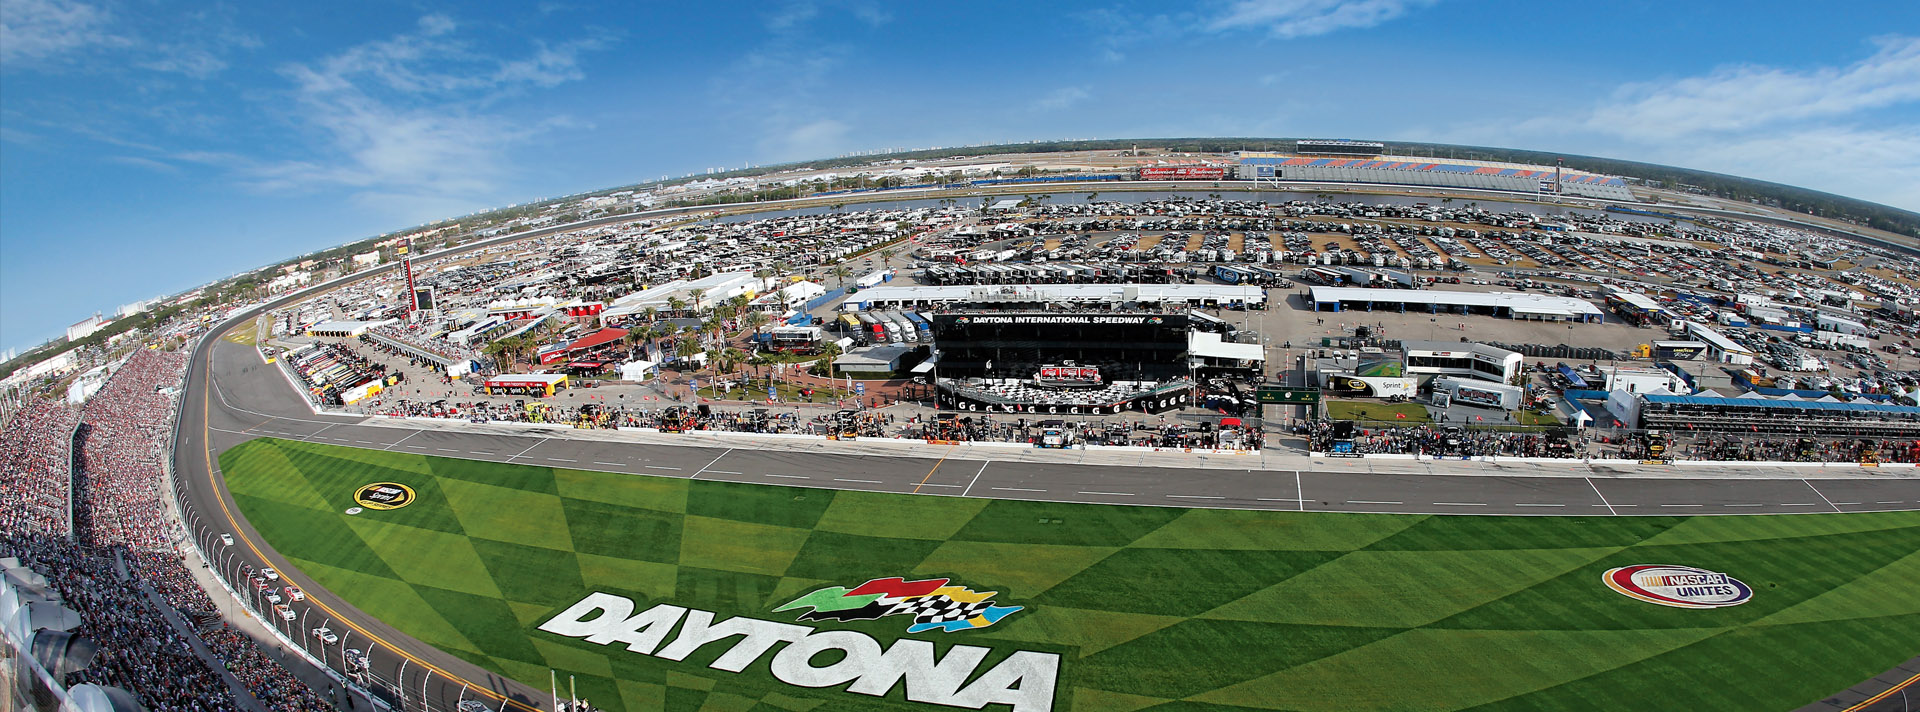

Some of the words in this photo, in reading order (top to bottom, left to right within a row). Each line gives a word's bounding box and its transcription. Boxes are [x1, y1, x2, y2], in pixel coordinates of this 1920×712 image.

[1669, 574, 1724, 586] NASCAR
[1676, 585, 1733, 597] UNITES
[537, 590, 1060, 712] DAYTONA
